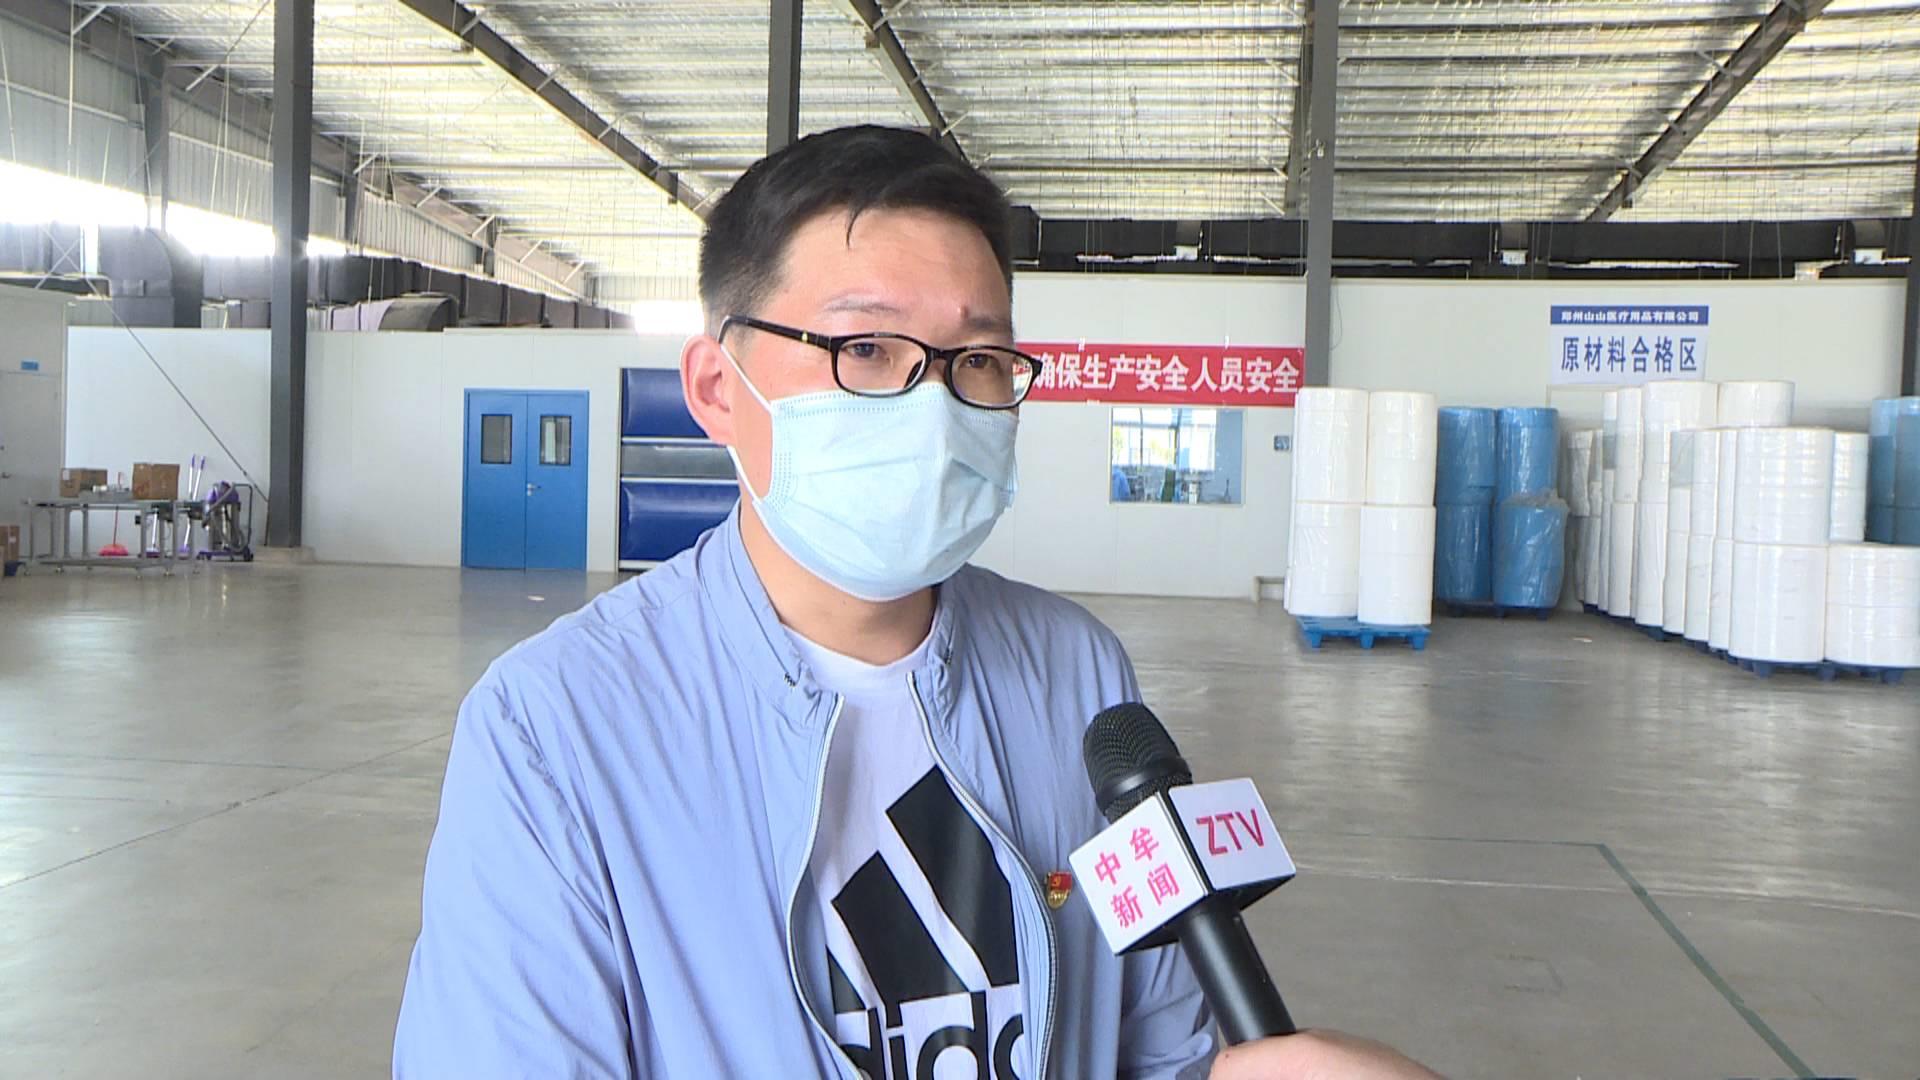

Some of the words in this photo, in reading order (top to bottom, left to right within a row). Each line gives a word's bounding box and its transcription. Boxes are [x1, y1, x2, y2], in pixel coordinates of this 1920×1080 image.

[1561, 336, 1697, 373] 原材料合格区
[1095, 827, 1159, 885] 中牟
[1196, 809, 1264, 856] ZTV
[1110, 863, 1181, 928] 新闻
